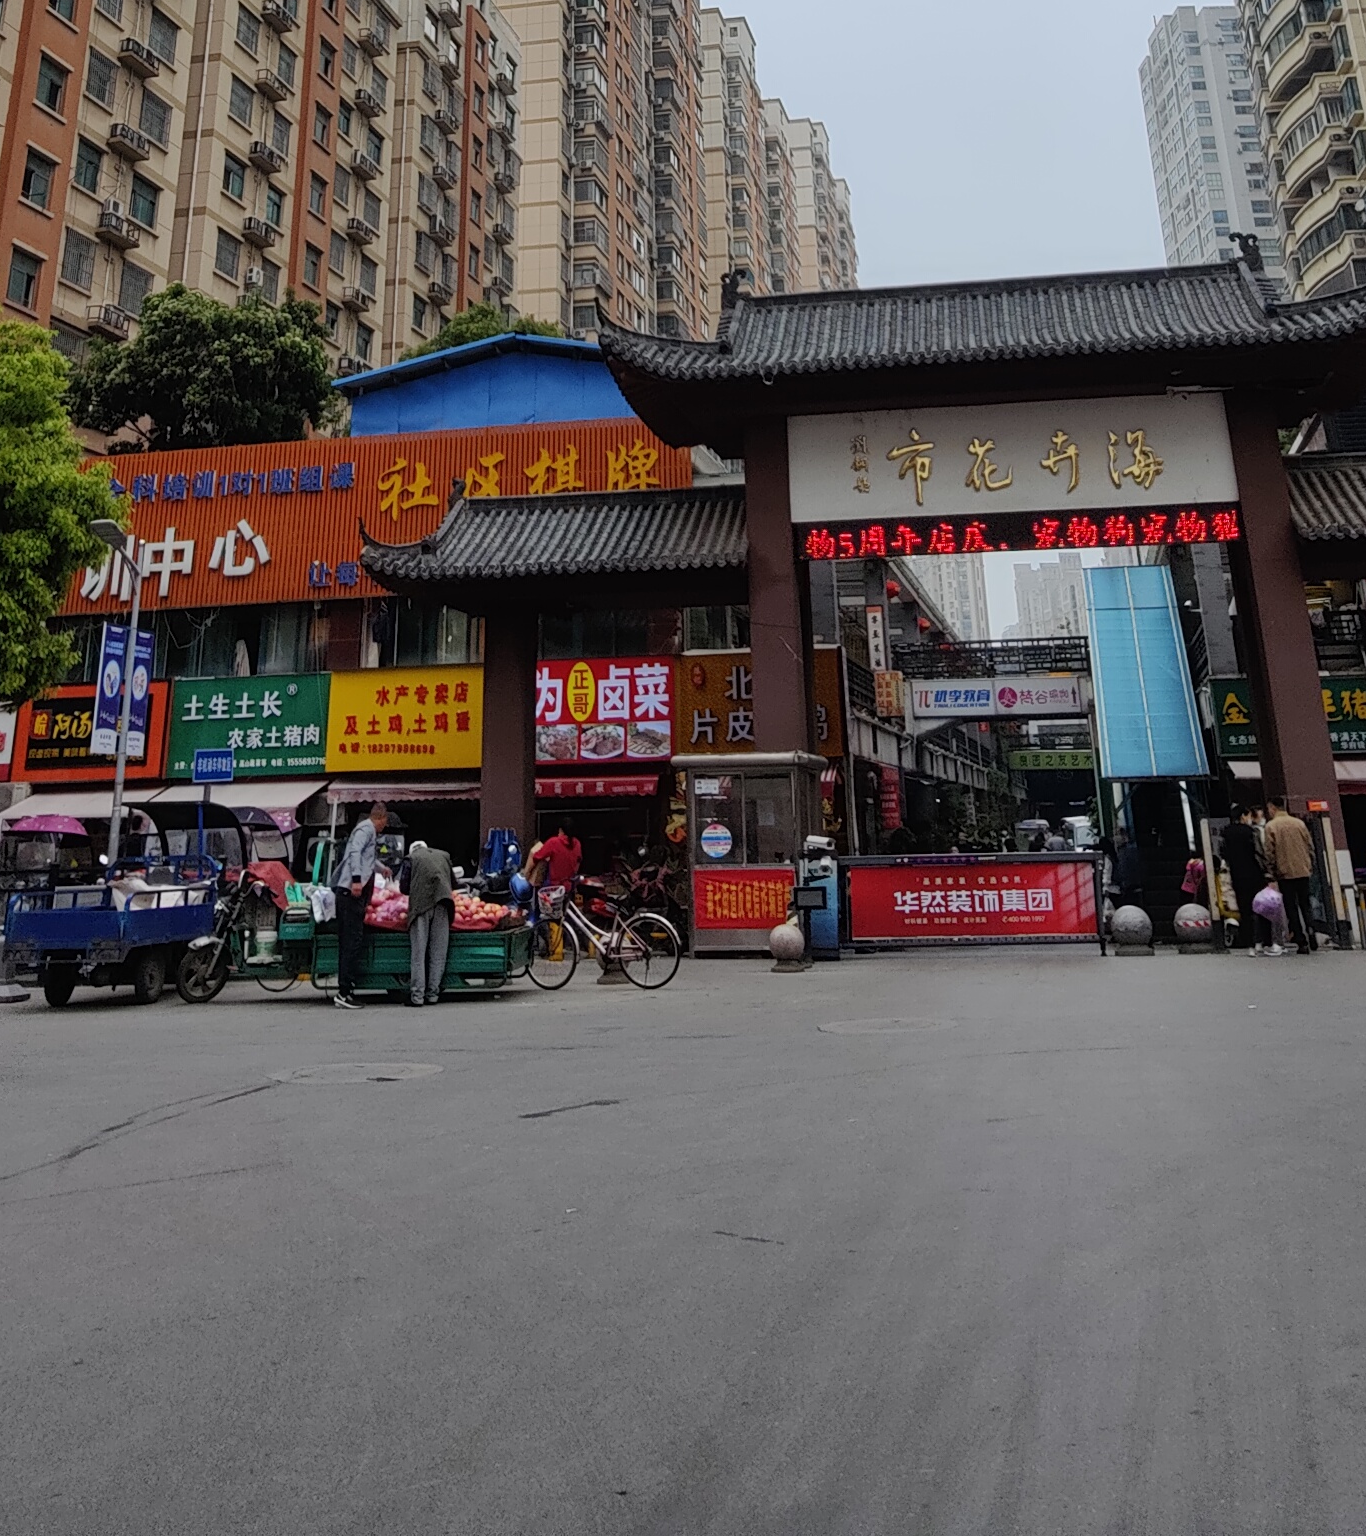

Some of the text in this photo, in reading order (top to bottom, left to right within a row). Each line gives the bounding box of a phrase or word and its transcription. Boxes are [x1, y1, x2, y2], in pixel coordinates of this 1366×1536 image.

[376, 681, 470, 707] 水产专卖店
[227, 723, 321, 750] 农家土猪肉
[894, 889, 1054, 914] 华然装饰集团
